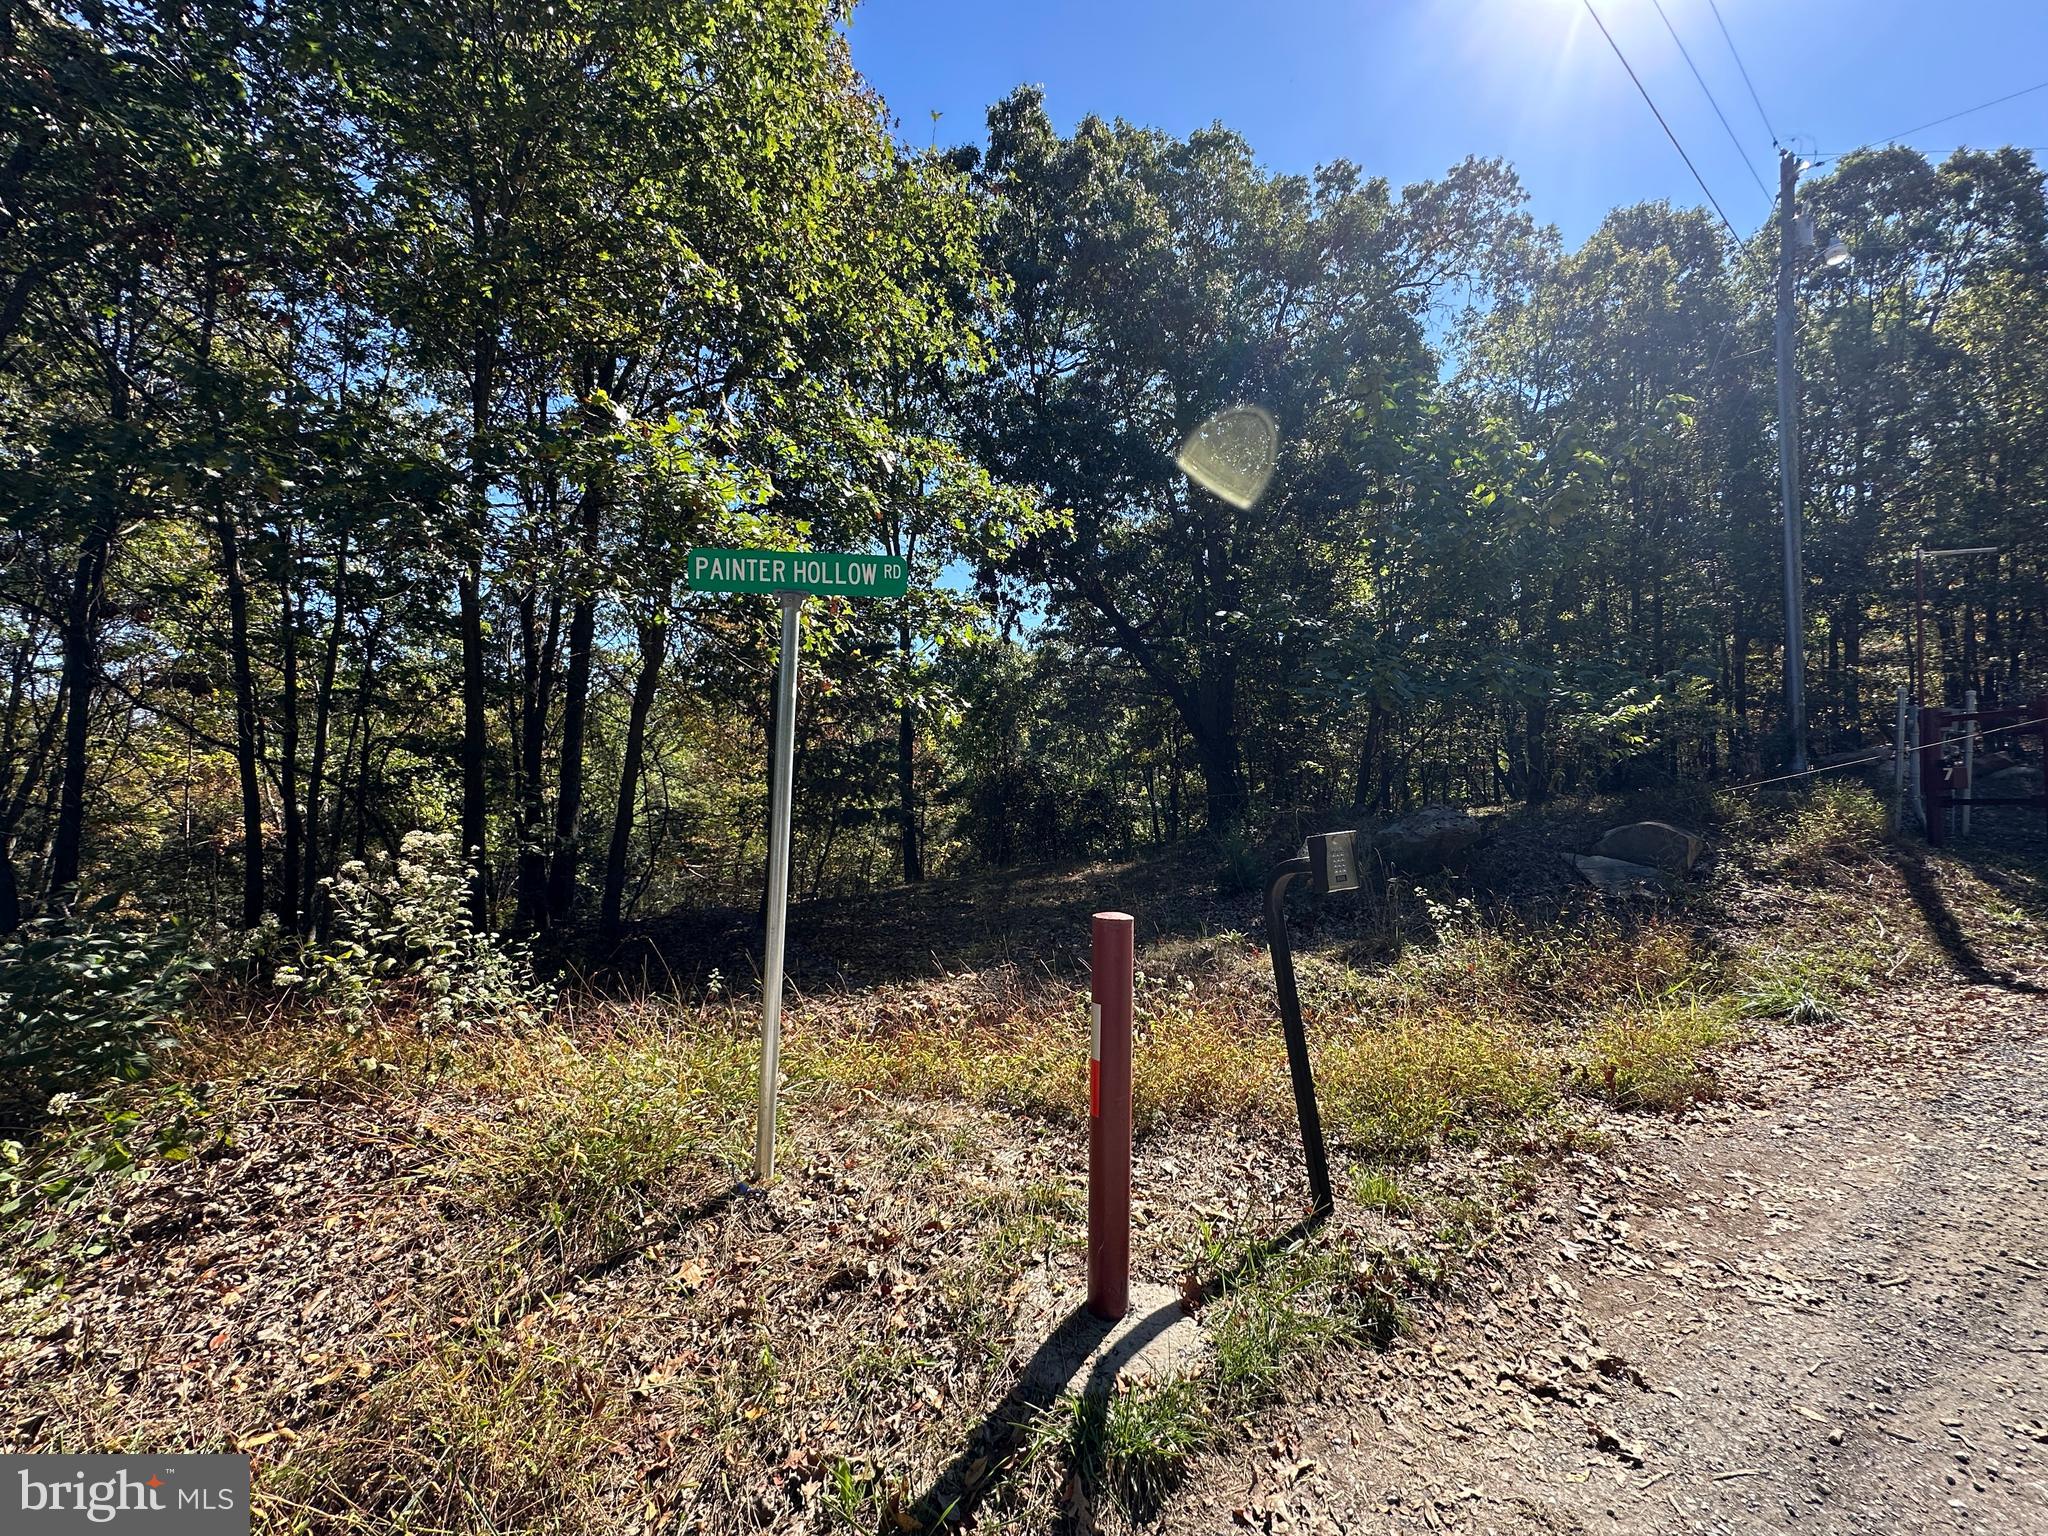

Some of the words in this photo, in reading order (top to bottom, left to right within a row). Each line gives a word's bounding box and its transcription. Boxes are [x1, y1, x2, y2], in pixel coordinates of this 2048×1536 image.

[695, 556, 785, 583] PAINTER
[793, 560, 877, 586] HOLLOW
[884, 564, 902, 580] RD
[1942, 767, 1954, 781] 7
